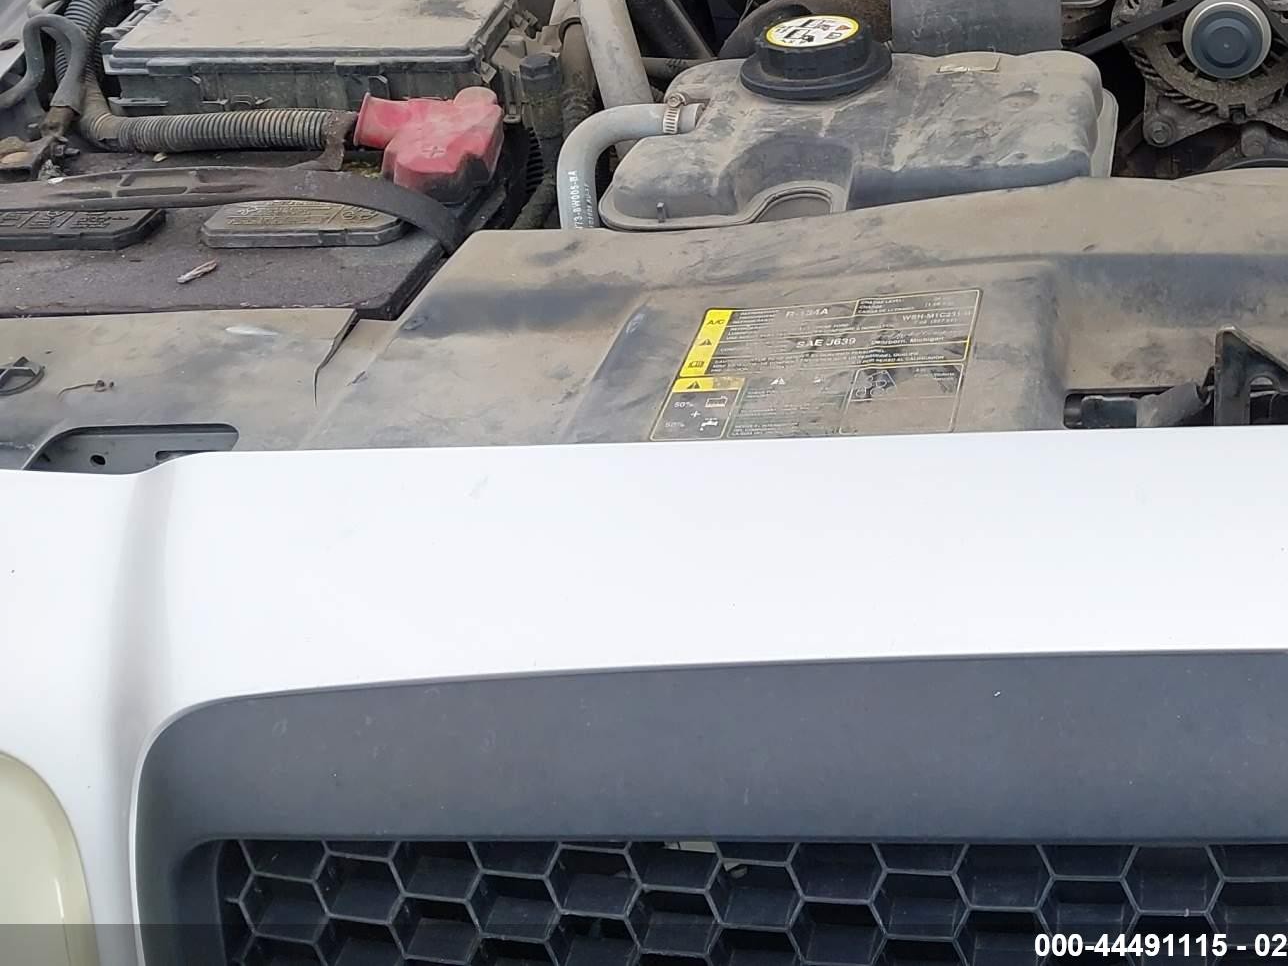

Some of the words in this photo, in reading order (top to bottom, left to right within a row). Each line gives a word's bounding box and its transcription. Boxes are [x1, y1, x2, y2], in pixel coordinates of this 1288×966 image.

[785, 308, 829, 318] R-134A
[796, 339, 823, 348] SAE
[826, 337, 856, 346] J639
